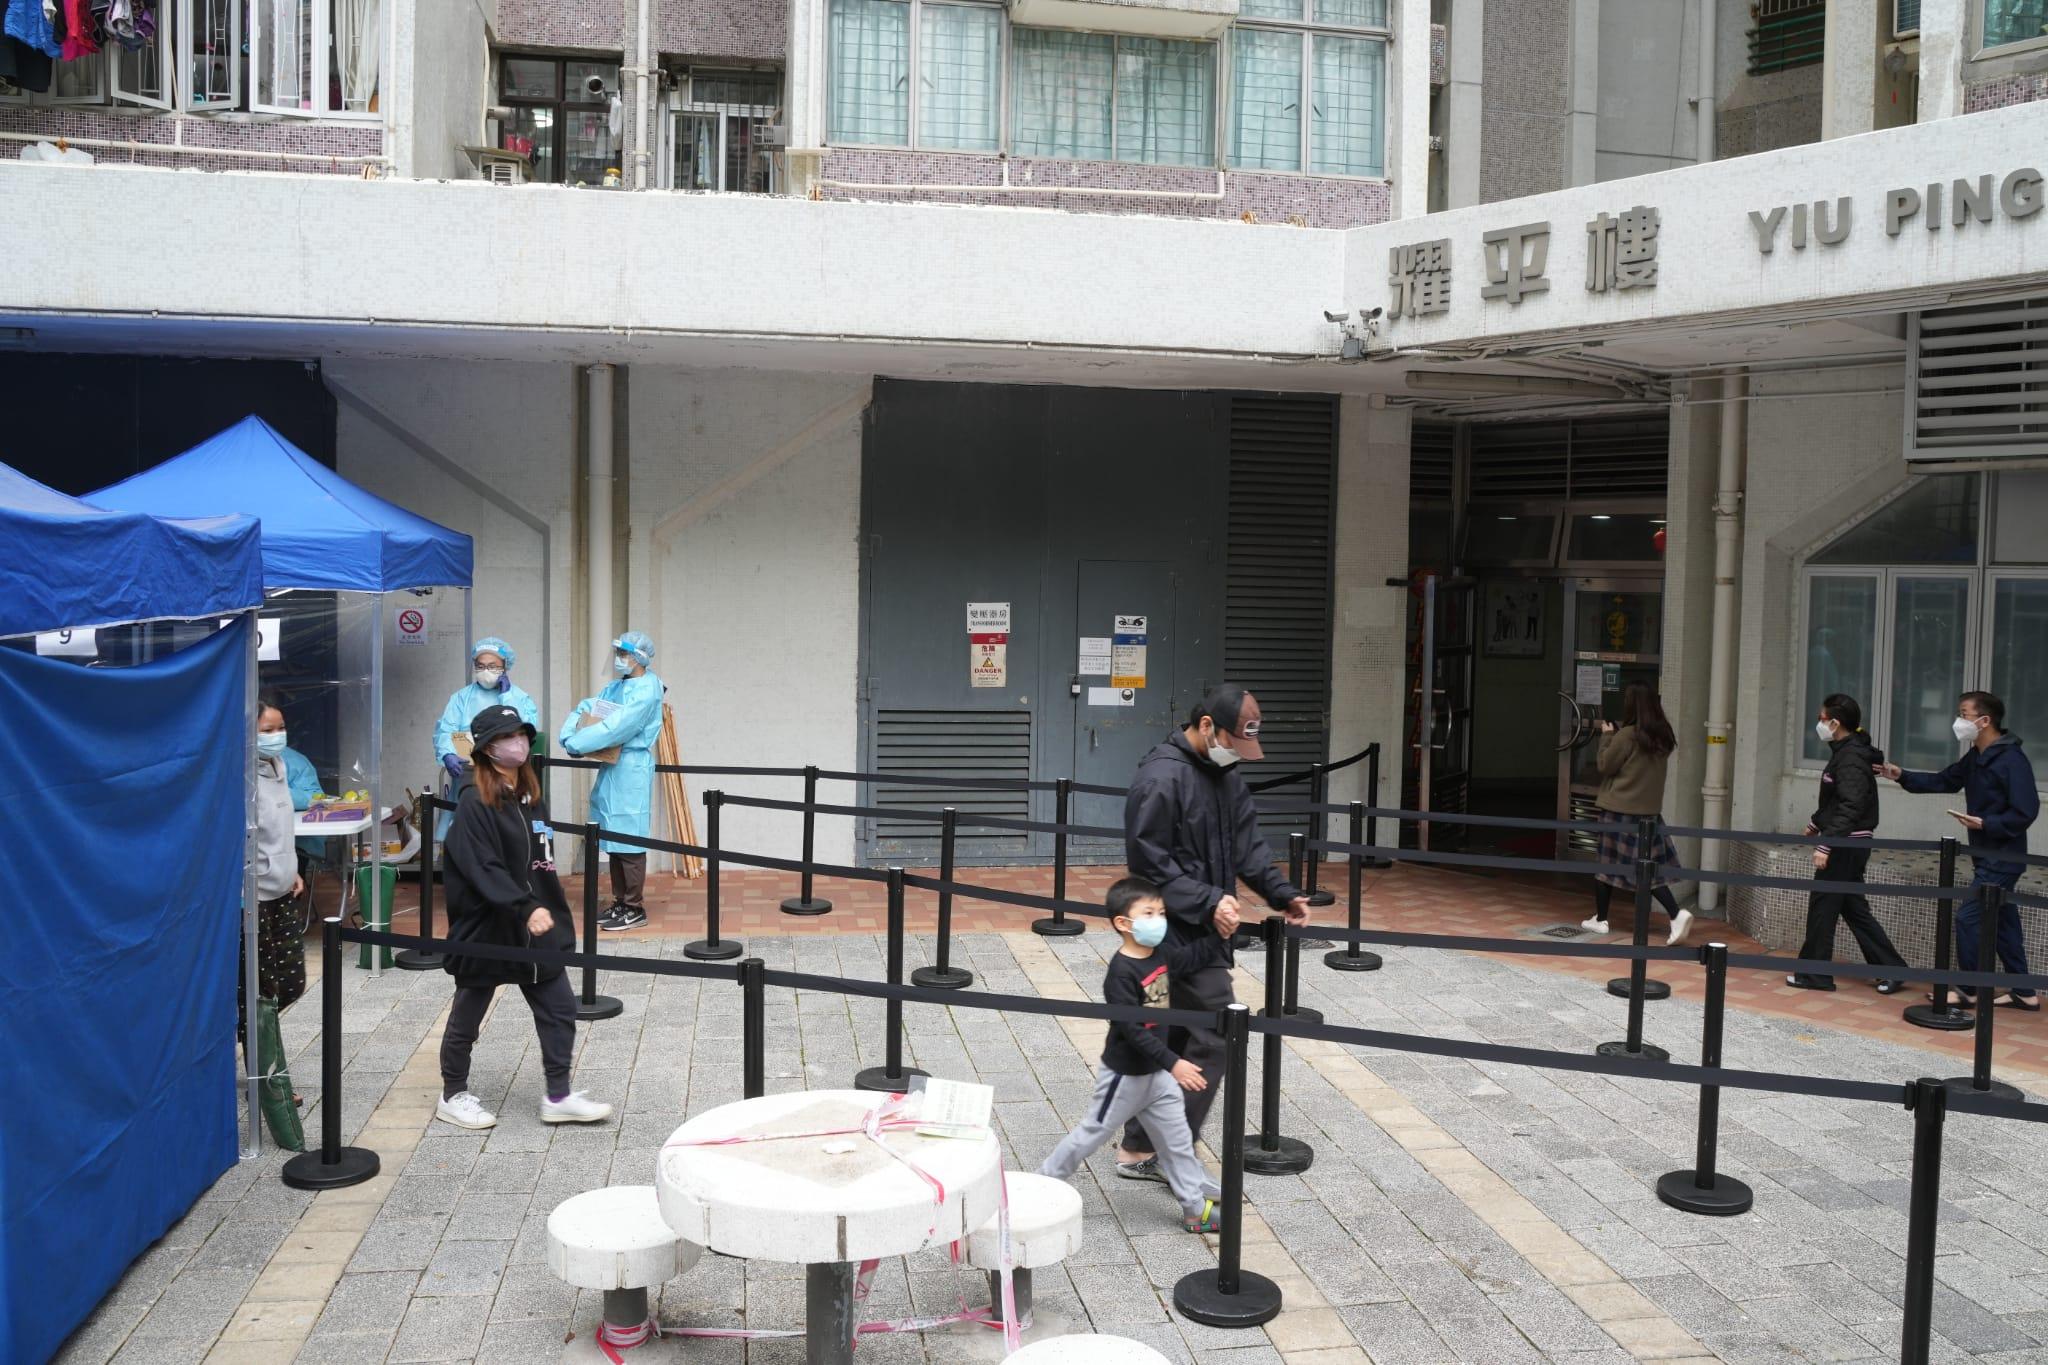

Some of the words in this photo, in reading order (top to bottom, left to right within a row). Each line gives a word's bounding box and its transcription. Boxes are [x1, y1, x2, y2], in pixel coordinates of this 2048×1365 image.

[1748, 196, 1853, 253] YIU
[1886, 167, 2044, 236] PING
[1387, 206, 1660, 320] 耀平樓
[59, 629, 72, 645] 9
